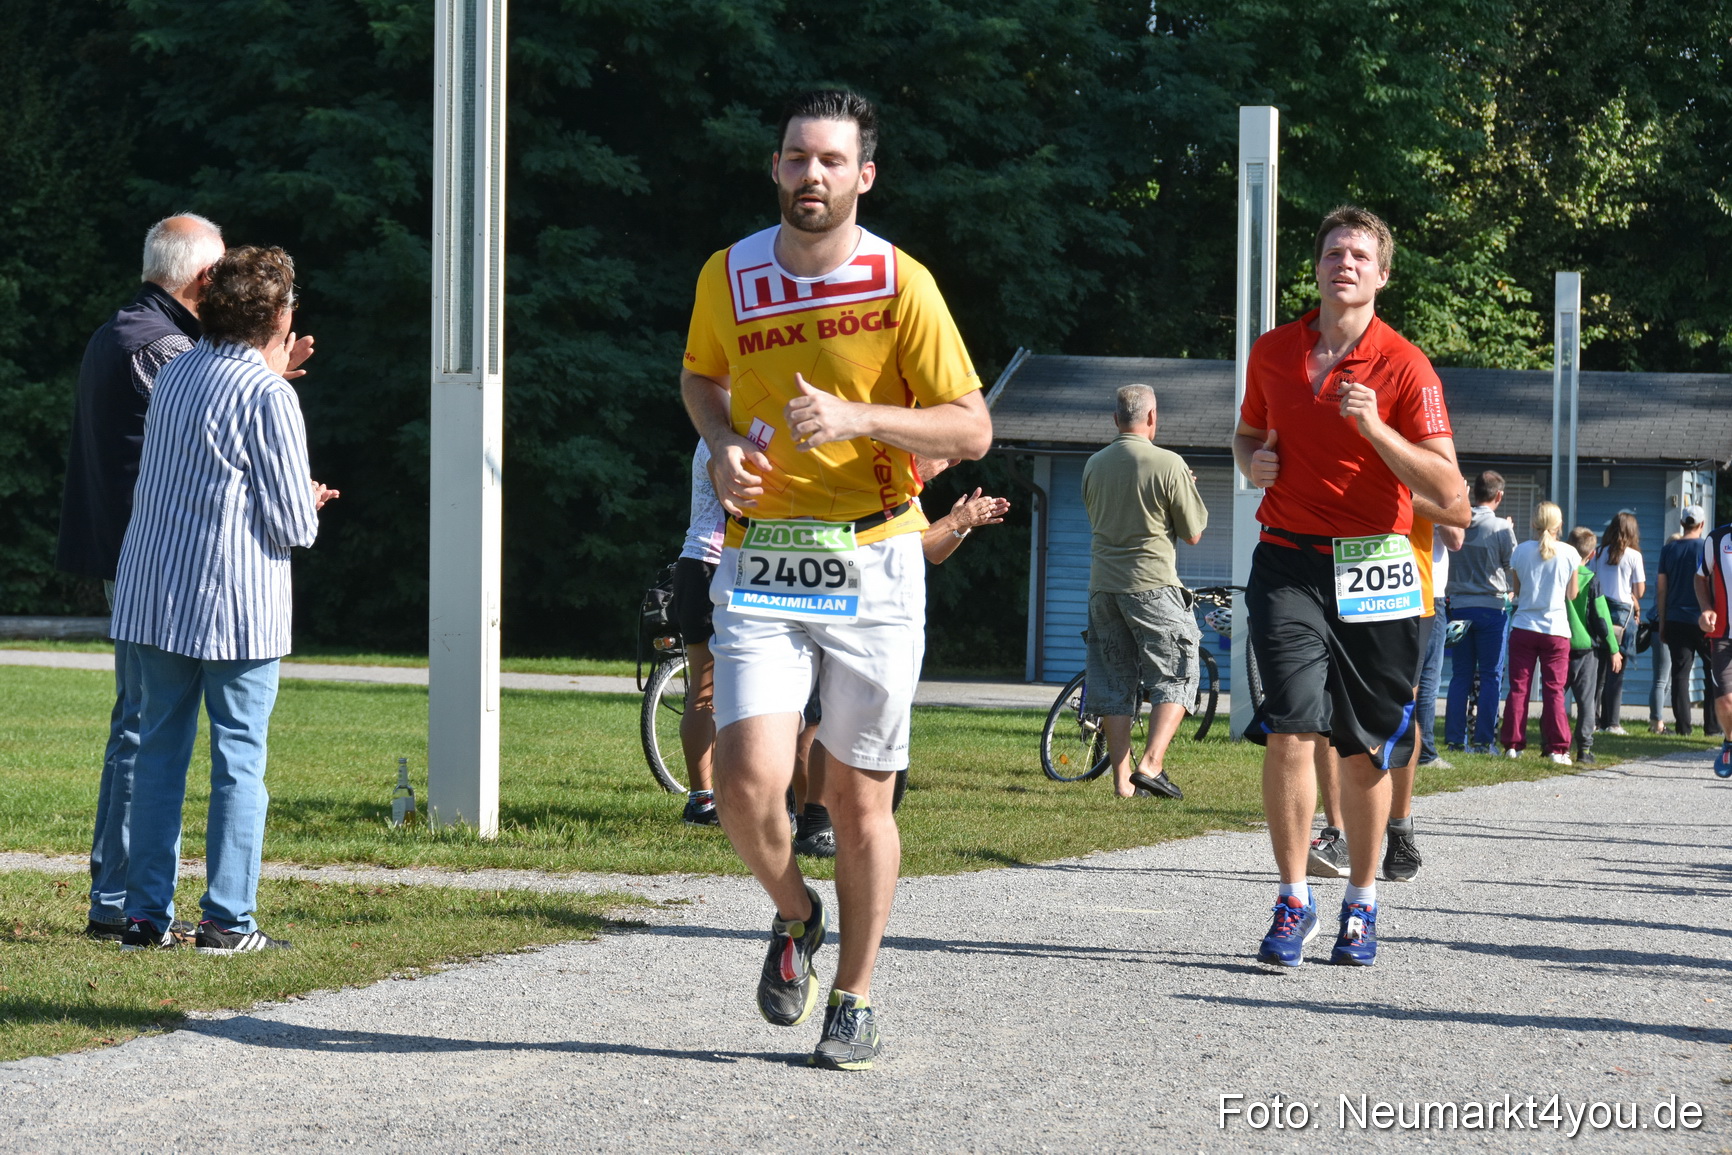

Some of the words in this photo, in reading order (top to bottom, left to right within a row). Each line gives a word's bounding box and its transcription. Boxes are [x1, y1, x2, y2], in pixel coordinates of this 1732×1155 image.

[738, 323, 807, 356] MAX
[817, 310, 900, 340] BÖGL
[872, 445, 898, 510] max
[750, 524, 847, 549] BOCK
[750, 556, 846, 588] 2409
[1347, 561, 1414, 592] 2058
[743, 592, 847, 611] MAXIMILIAN
[1357, 596, 1411, 612] JÜRGEN
